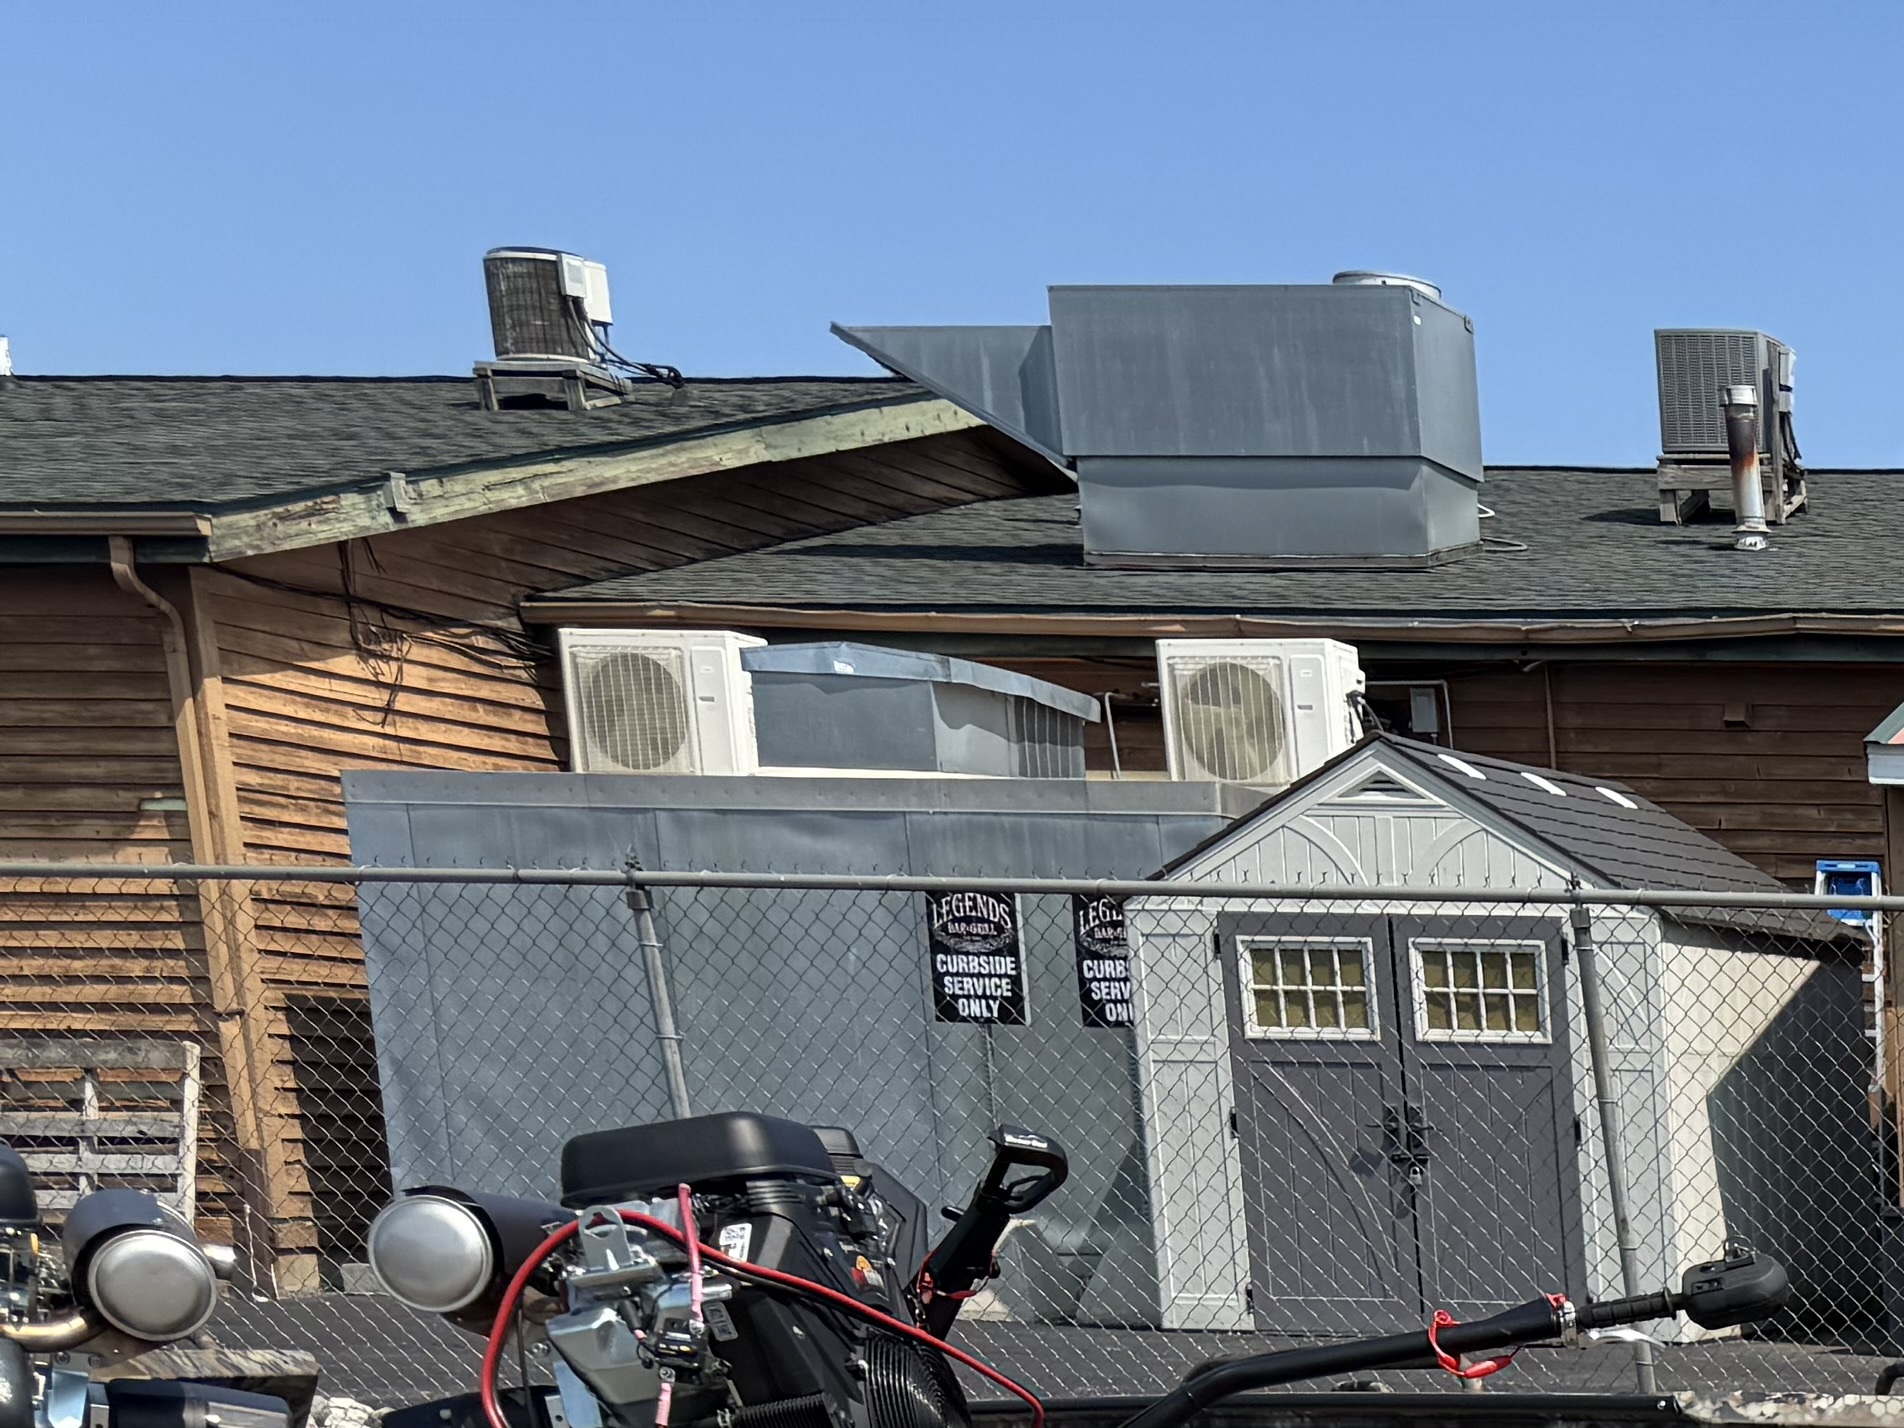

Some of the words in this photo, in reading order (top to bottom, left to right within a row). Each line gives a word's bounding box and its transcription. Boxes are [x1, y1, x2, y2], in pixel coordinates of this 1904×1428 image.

[933, 893, 1012, 929] LEGENDS
[936, 954, 1017, 975] CURBSIDE
[1082, 959, 1129, 978] CURB
[943, 976, 1012, 997] SERVICE
[957, 998, 1000, 1017] ONLY
